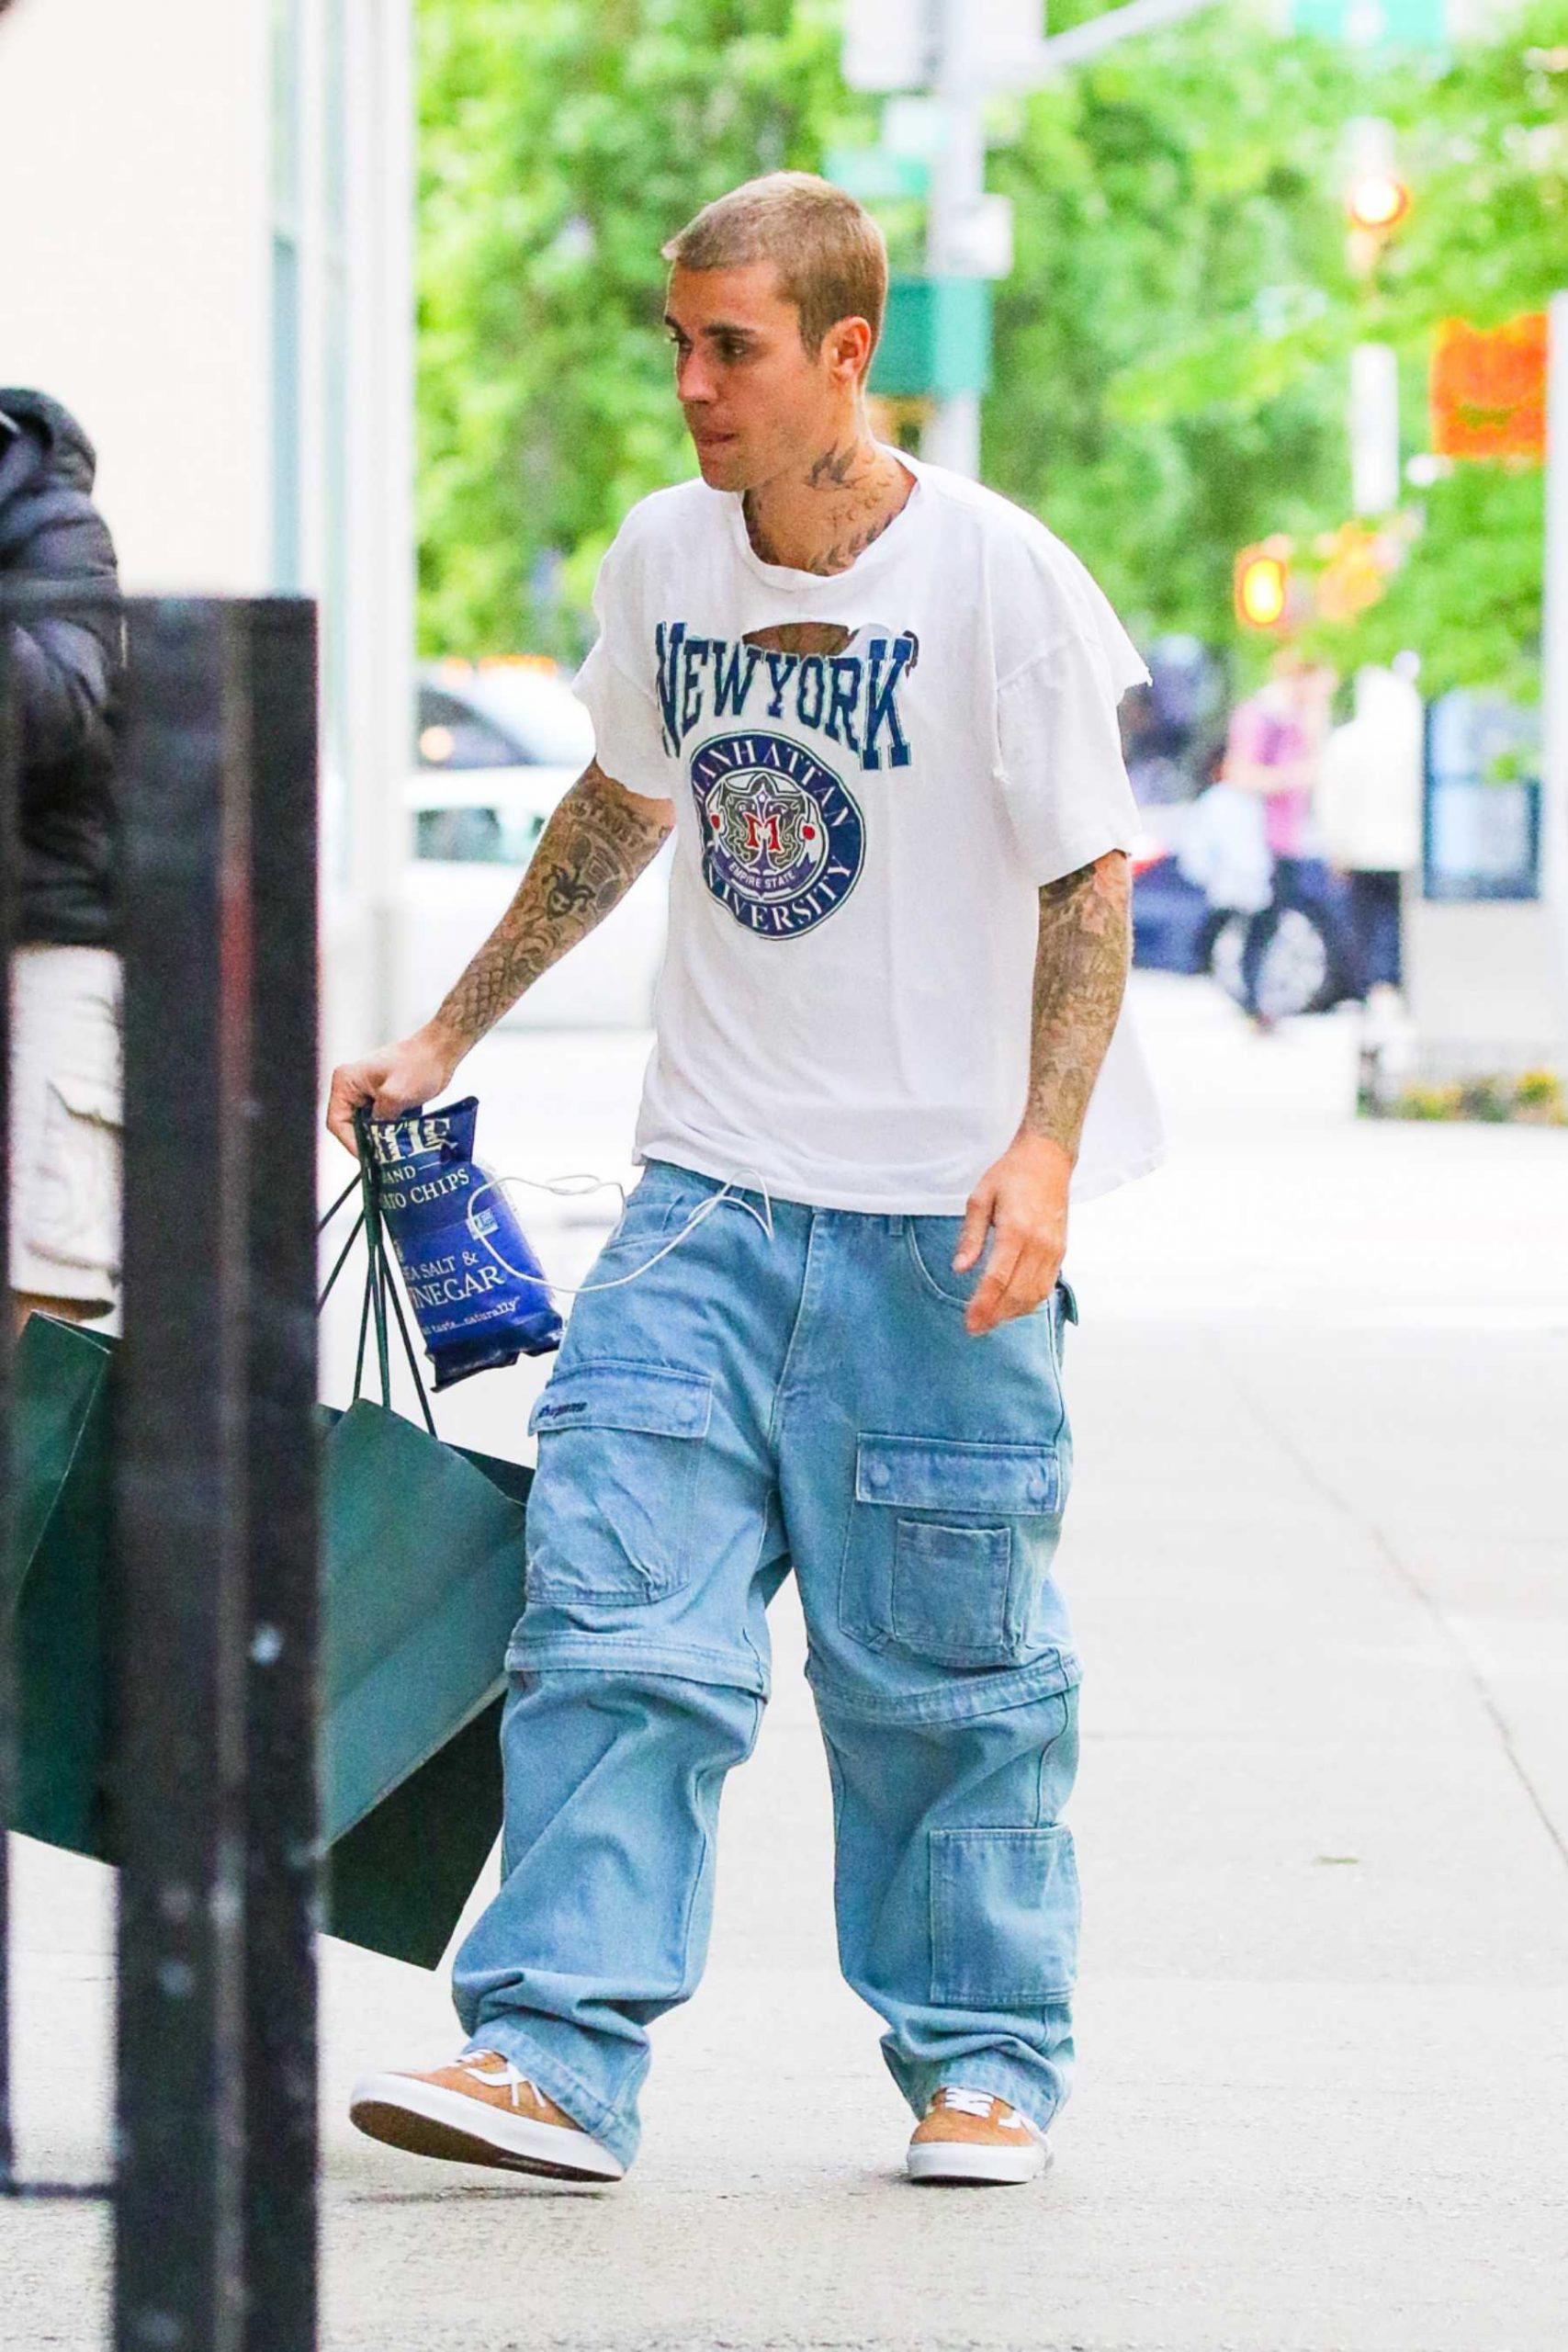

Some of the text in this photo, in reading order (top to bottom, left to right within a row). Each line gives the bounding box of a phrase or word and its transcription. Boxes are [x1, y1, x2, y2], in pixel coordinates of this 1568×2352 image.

[654, 621, 913, 772] NEW YORK
[706, 854, 852, 932] NIVERSITY
[728, 861, 797, 889] EMPIRE STATE
[410, 1167, 470, 1204] CHIPS
[401, 1250, 479, 1282] EA SALT &
[408, 1265, 507, 1309] INEGAR
